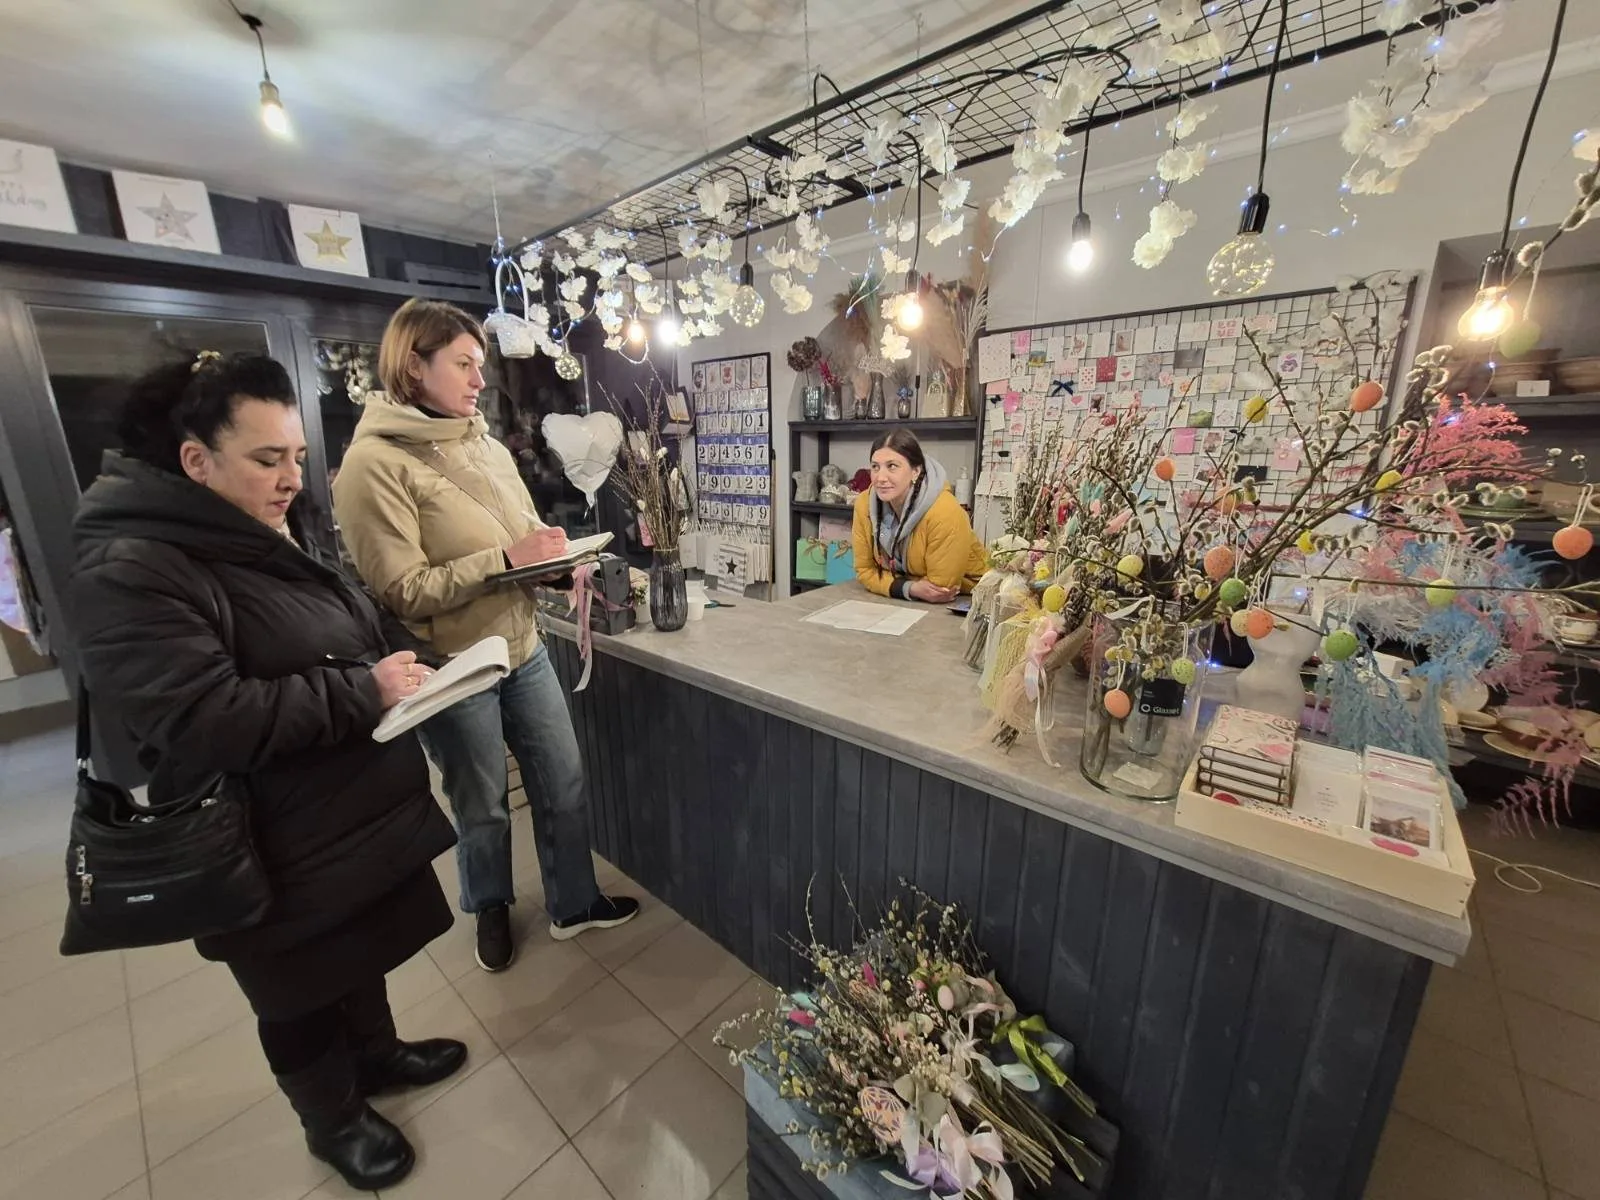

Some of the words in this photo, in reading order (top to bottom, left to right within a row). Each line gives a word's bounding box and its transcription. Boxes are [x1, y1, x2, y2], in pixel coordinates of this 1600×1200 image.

[744, 413, 753, 427] 0
[758, 412, 764, 427] 1
[699, 446, 706, 458] 2
[710, 445, 716, 459] 3
[722, 445, 729, 458] 4
[734, 445, 741, 458] 5
[744, 446, 752, 460] 6
[758, 445, 765, 459] 7
[711, 475, 718, 488] 9
[723, 475, 731, 489] 0
[745, 476, 753, 489] 2
[759, 476, 766, 490] 3
[701, 501, 708, 514] 4
[712, 502, 719, 515] 5
[723, 504, 730, 517] 6
[735, 504, 742, 517] 7
[759, 506, 767, 519] 9
